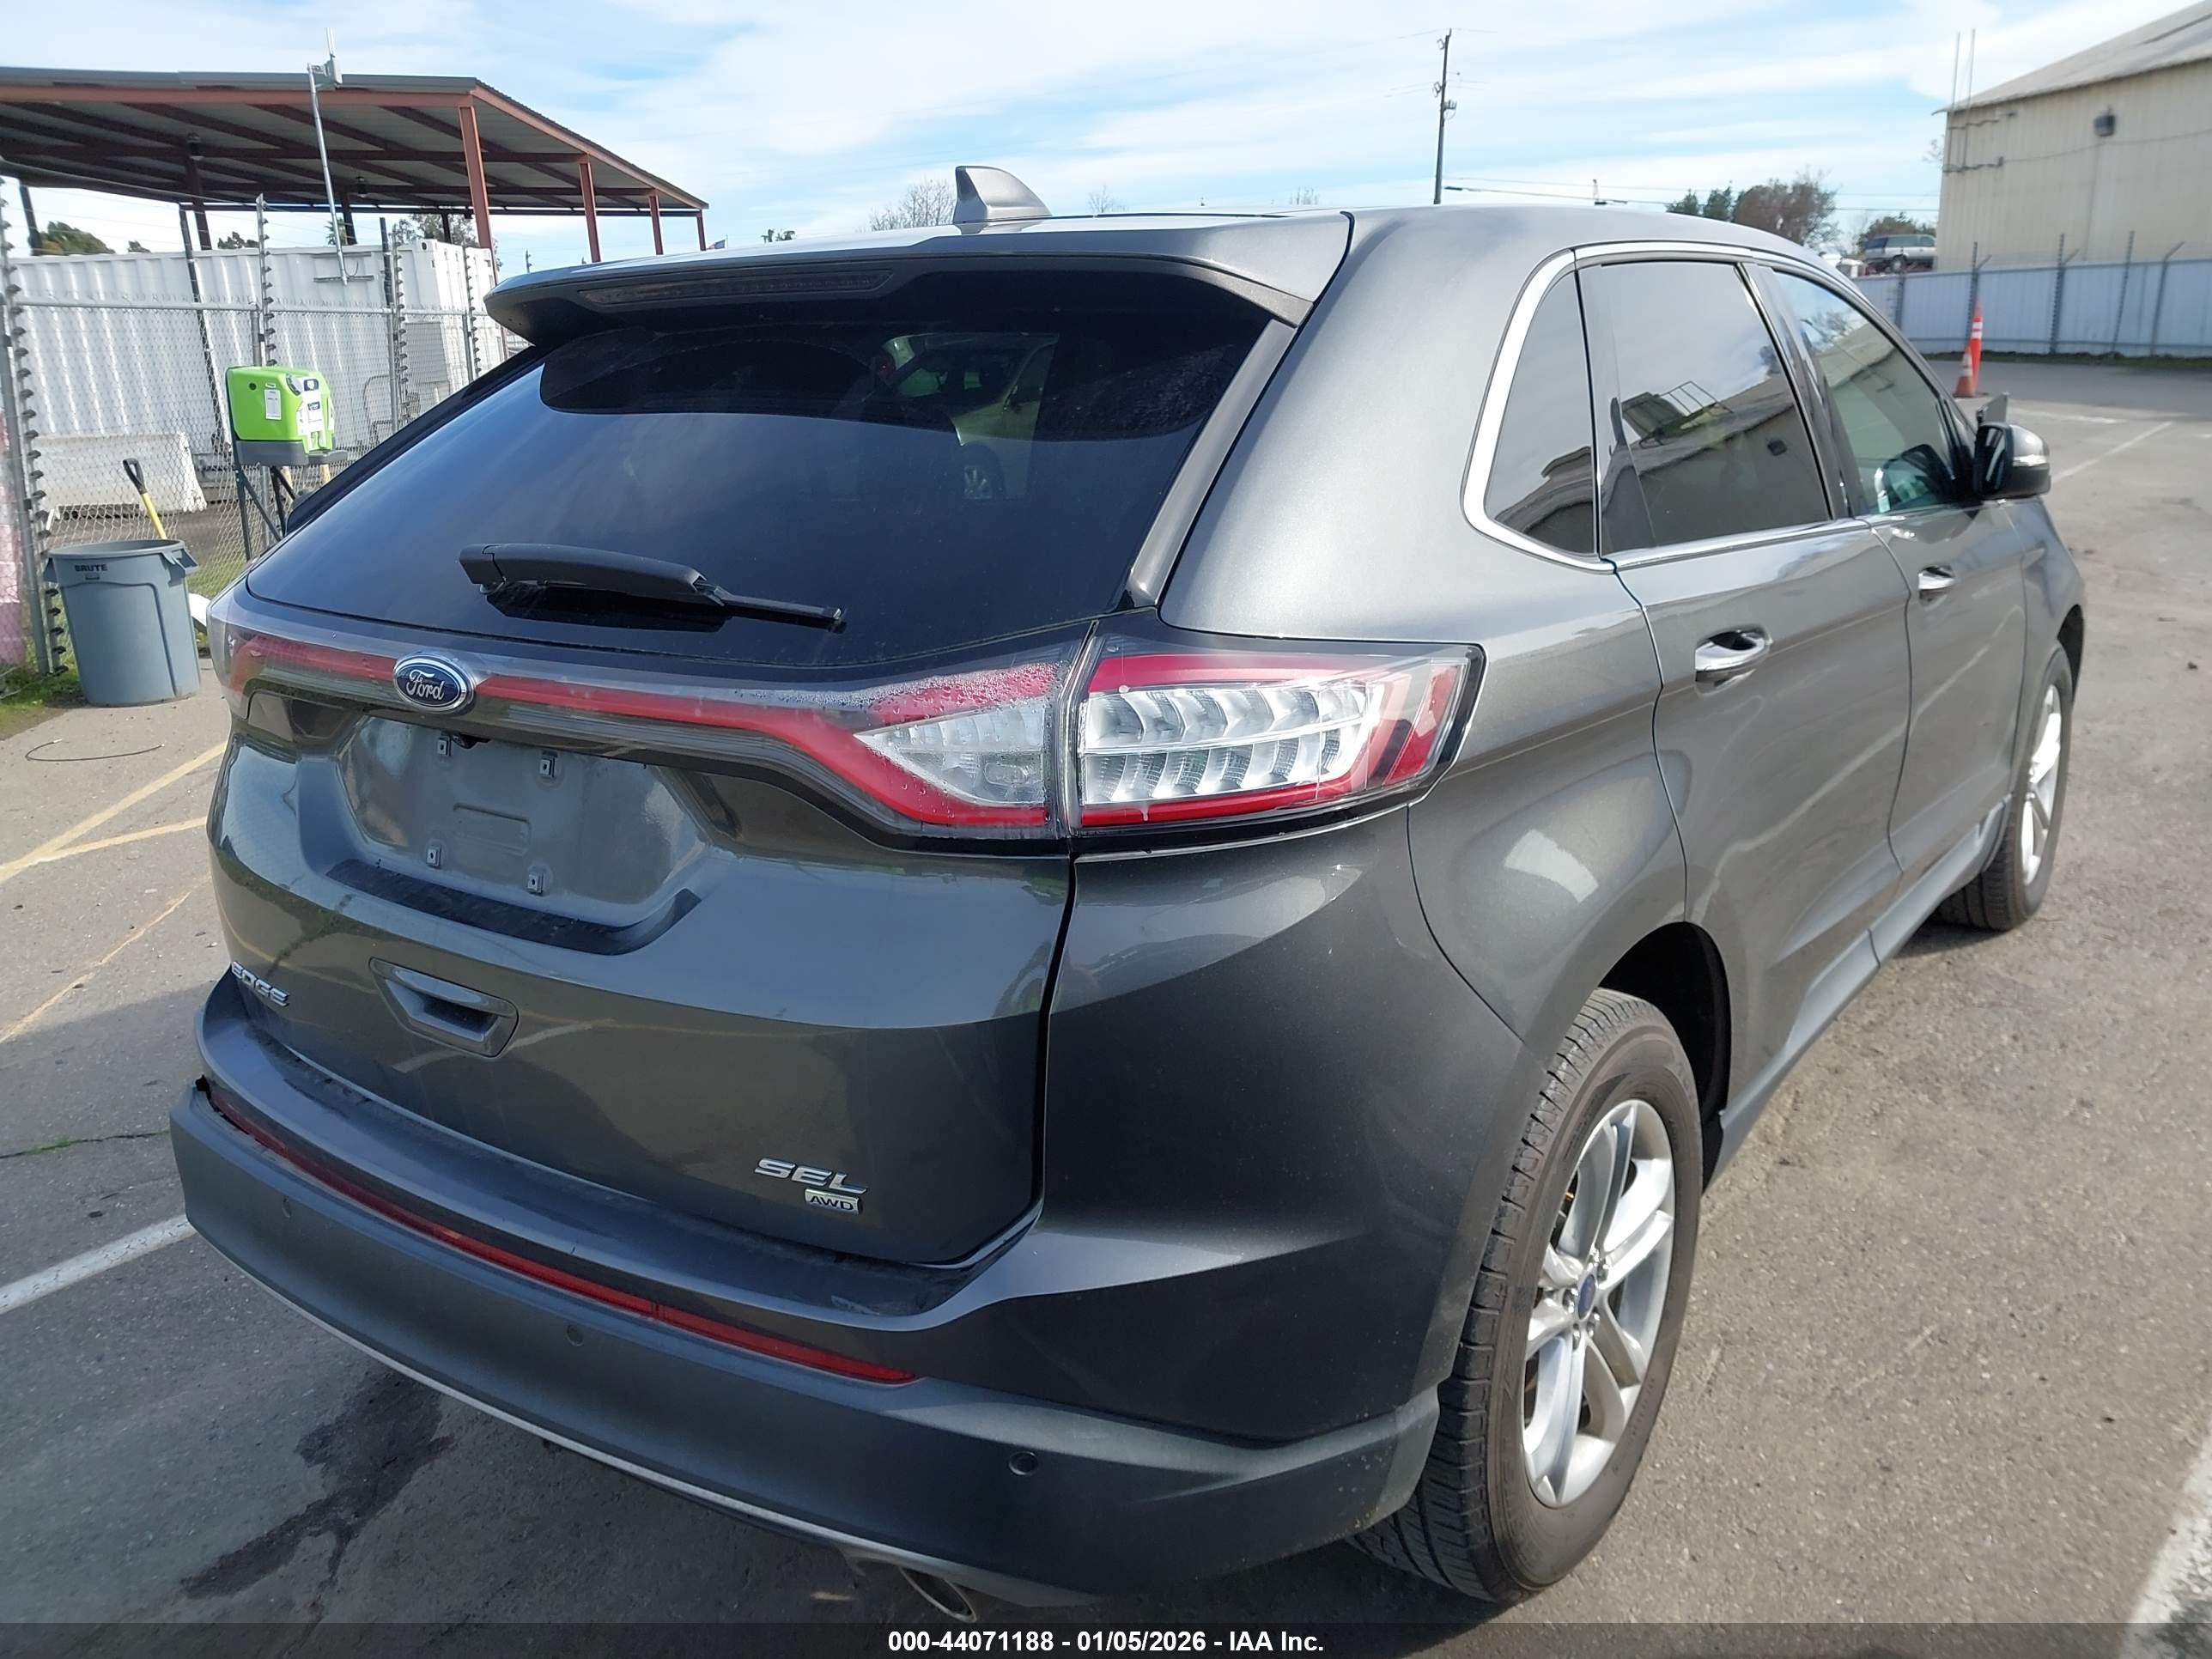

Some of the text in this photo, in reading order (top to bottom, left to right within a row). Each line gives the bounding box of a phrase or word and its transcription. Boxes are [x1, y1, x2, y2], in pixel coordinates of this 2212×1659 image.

[406, 670, 445, 700] Ford
[232, 962, 289, 1006] EDGE
[755, 1158, 867, 1194] SEL
[810, 1195, 854, 1211] AWD
